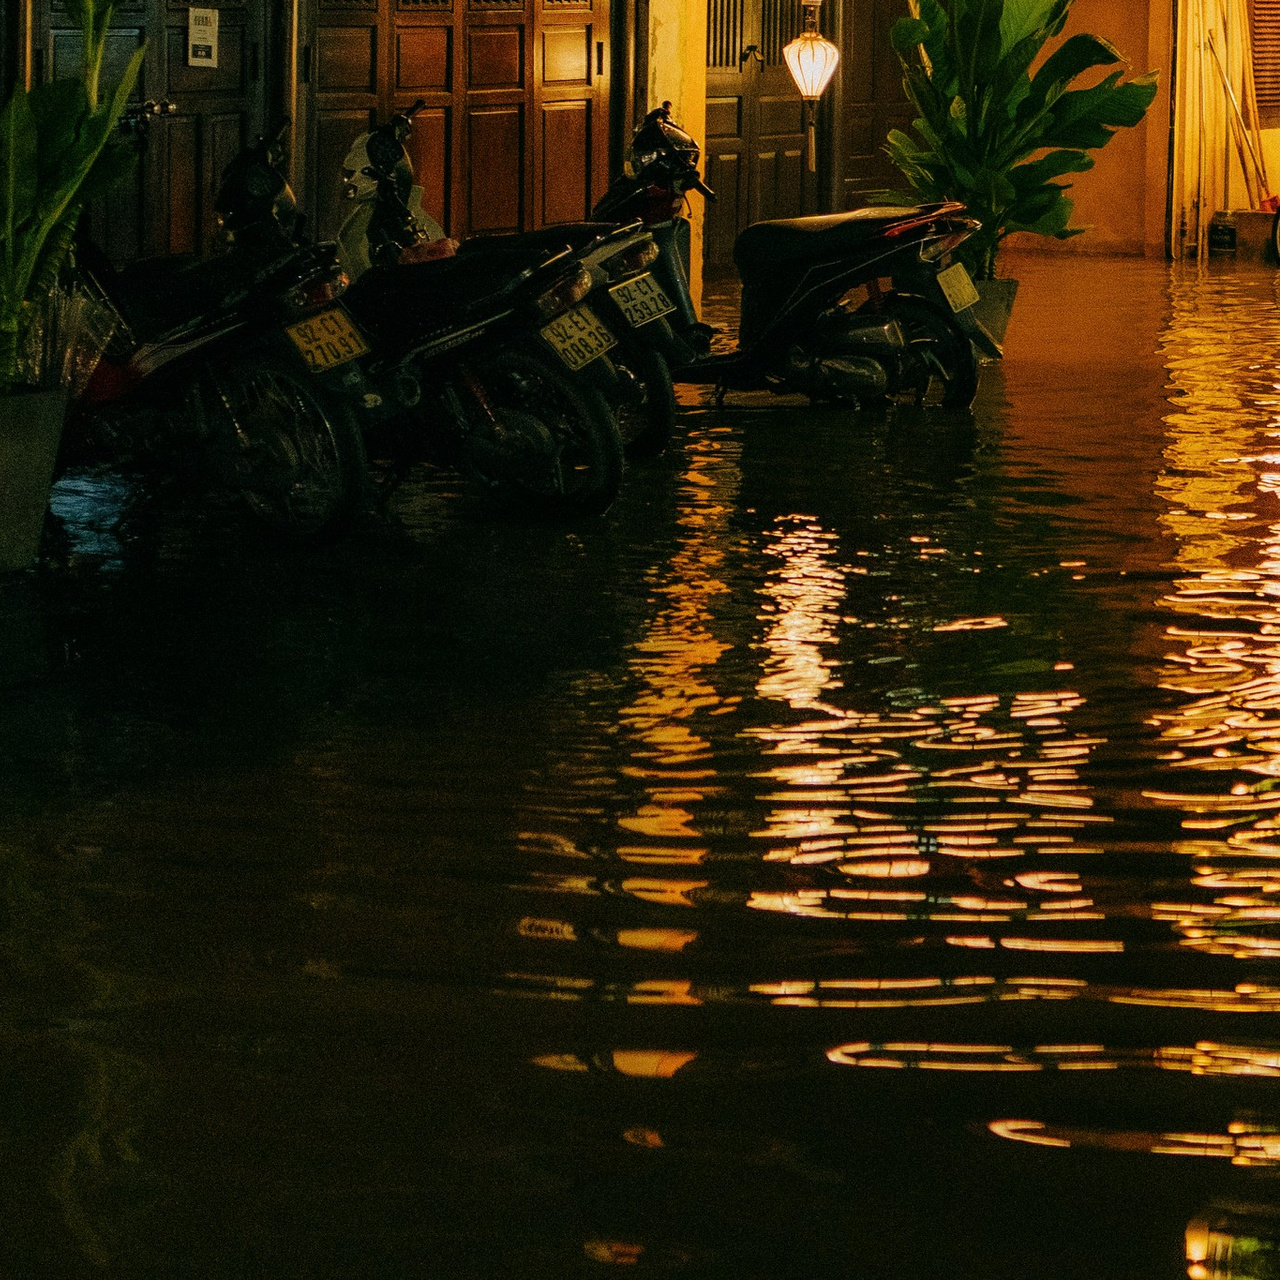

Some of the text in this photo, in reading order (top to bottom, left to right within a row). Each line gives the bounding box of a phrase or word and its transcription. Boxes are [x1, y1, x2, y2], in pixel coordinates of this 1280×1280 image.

[617, 279, 654, 304] 92-C1
[624, 292, 671, 324] 259.28
[551, 310, 592, 344] 92-E1
[561, 325, 612, 366] 088.36
